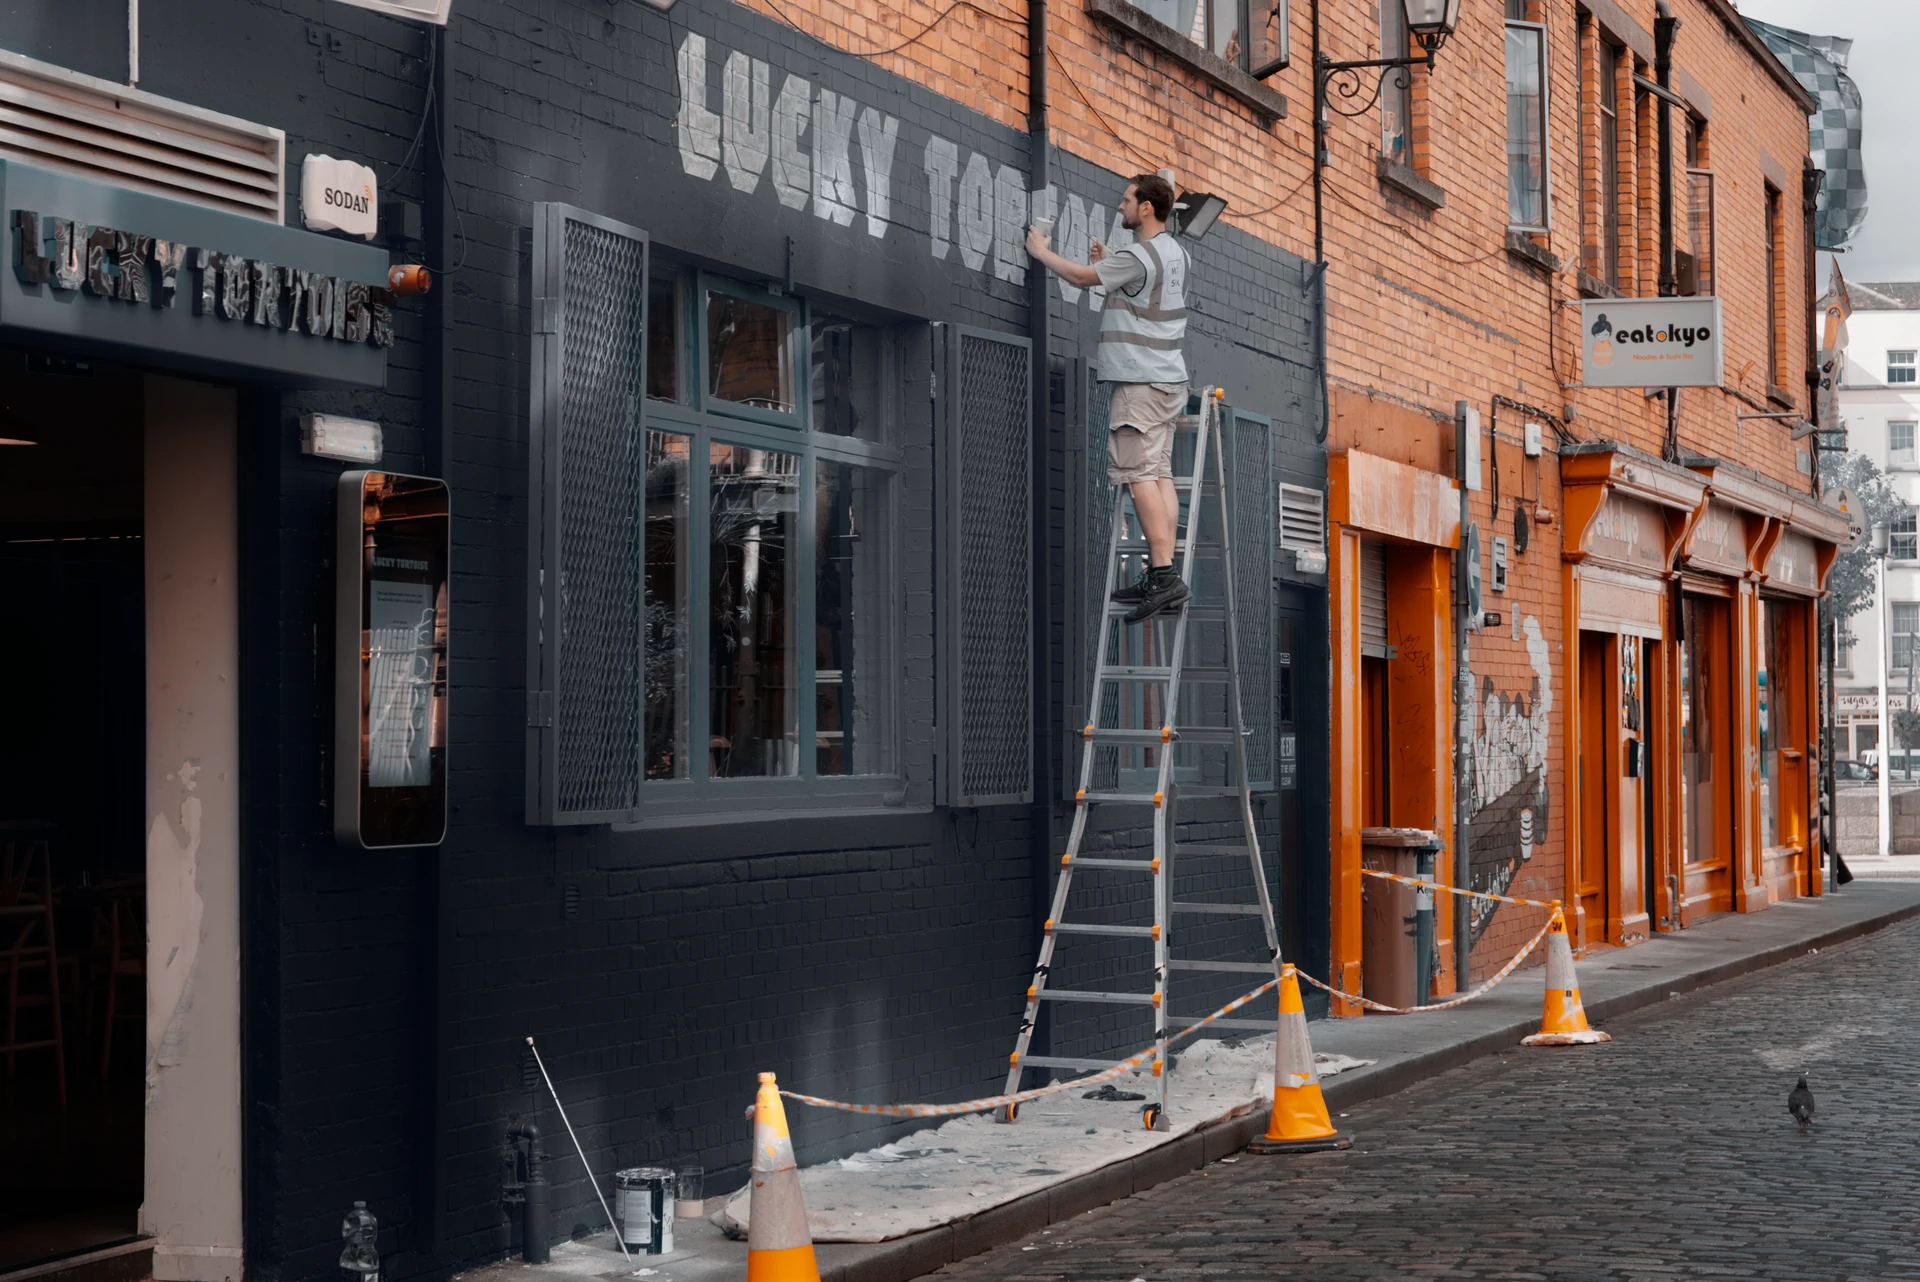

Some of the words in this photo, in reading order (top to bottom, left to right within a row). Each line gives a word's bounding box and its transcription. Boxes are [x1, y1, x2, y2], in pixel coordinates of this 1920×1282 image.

[678, 32, 899, 239] LUCKY
[324, 187, 369, 214] SODAN
[11, 209, 188, 308] LUCKY
[189, 247, 395, 348] TORTOISE
[1615, 323, 1711, 348] eatokyo
[1665, 353, 1682, 361] Sushi
[1683, 352, 1694, 360] Bar
[372, 556, 395, 568] LUCKY
[396, 558, 428, 570] TORTOISE
[1842, 696, 1869, 709] sugar
